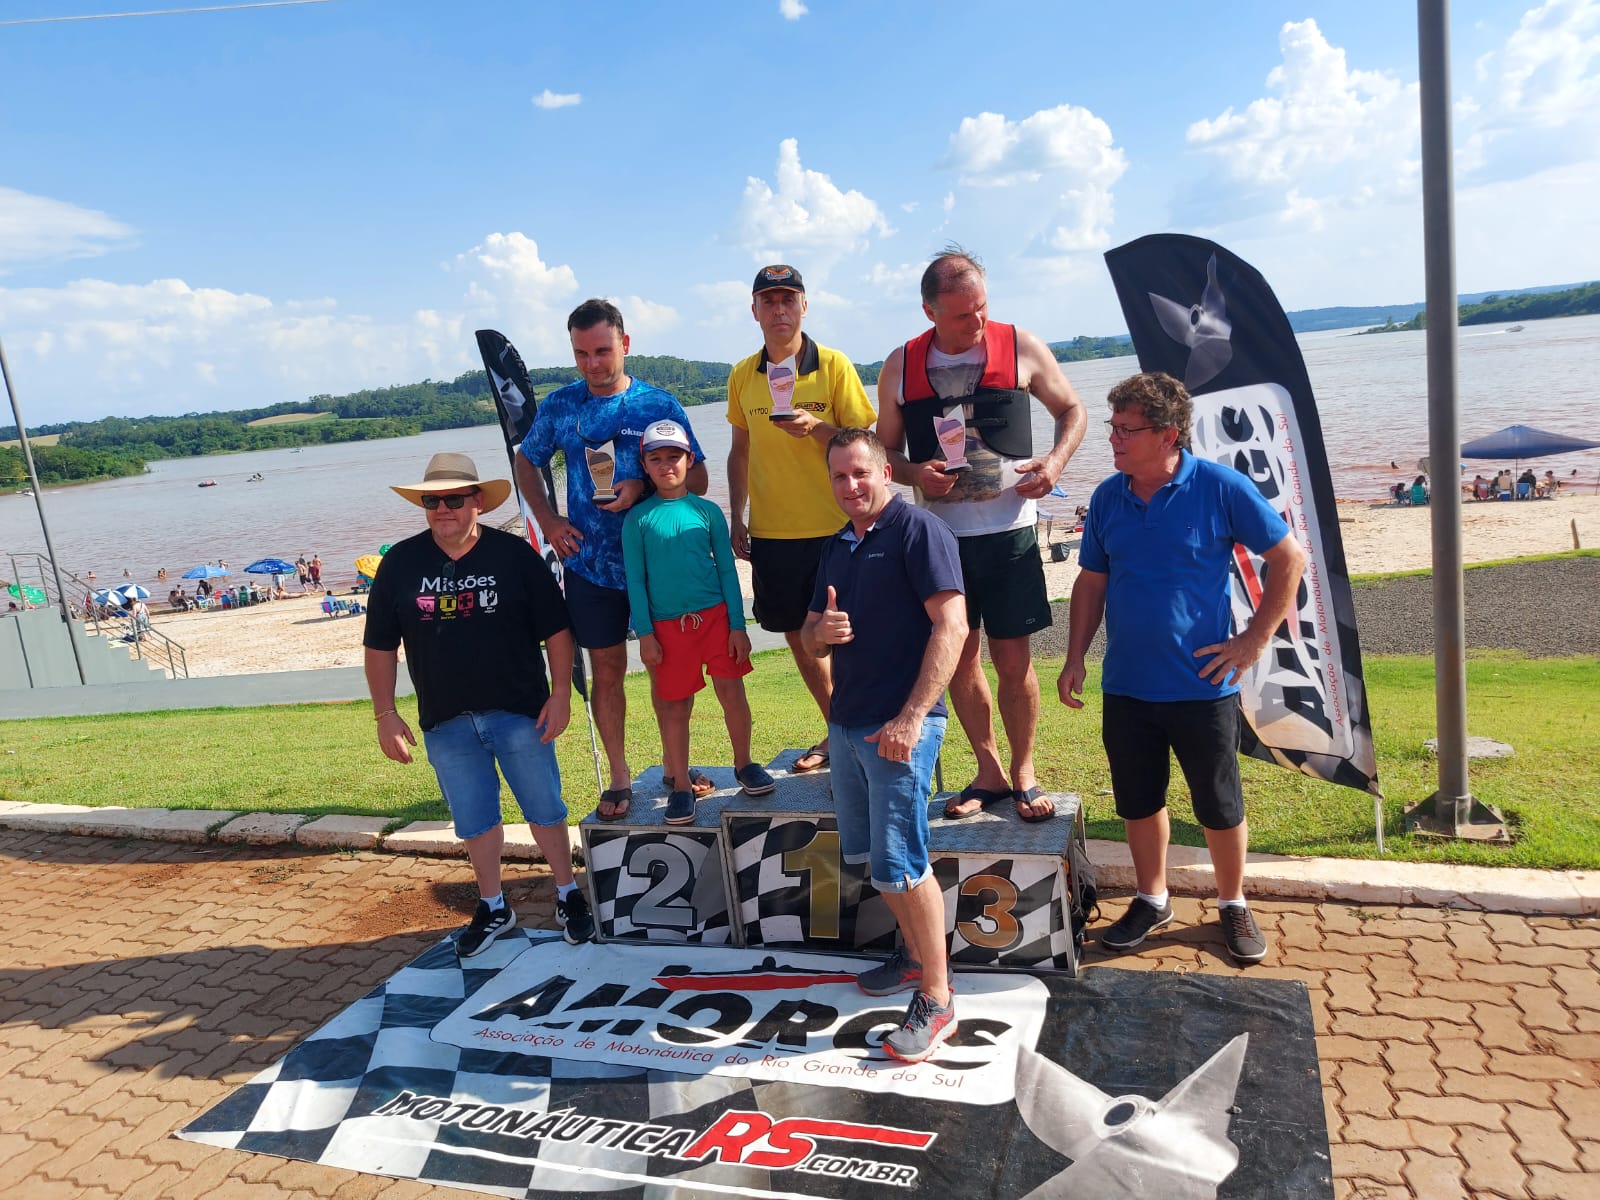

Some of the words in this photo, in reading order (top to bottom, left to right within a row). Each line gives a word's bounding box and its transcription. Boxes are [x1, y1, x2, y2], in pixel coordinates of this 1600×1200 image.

[1275, 413, 1289, 430] Sul
[1282, 438, 1294, 453] do
[1287, 461, 1304, 506] Grande
[1299, 513, 1309, 531] Rio
[1304, 538, 1314, 554] do
[419, 575, 497, 593] Missões
[1308, 562, 1329, 634] Motonáutica
[1322, 640, 1332, 656] de
[1326, 663, 1344, 728] Associação
[627, 842, 697, 929] 2
[782, 831, 841, 939] 1
[957, 873, 1021, 949] 3
[473, 1026, 564, 1048] Associação
[573, 1035, 596, 1050] de
[604, 1040, 714, 1063] Motonáutica
[725, 1051, 749, 1066] do
[760, 1053, 790, 1070] Rio
[803, 1058, 879, 1079] Grande
[891, 1068, 918, 1083] do
[931, 1072, 965, 1089] Sul
